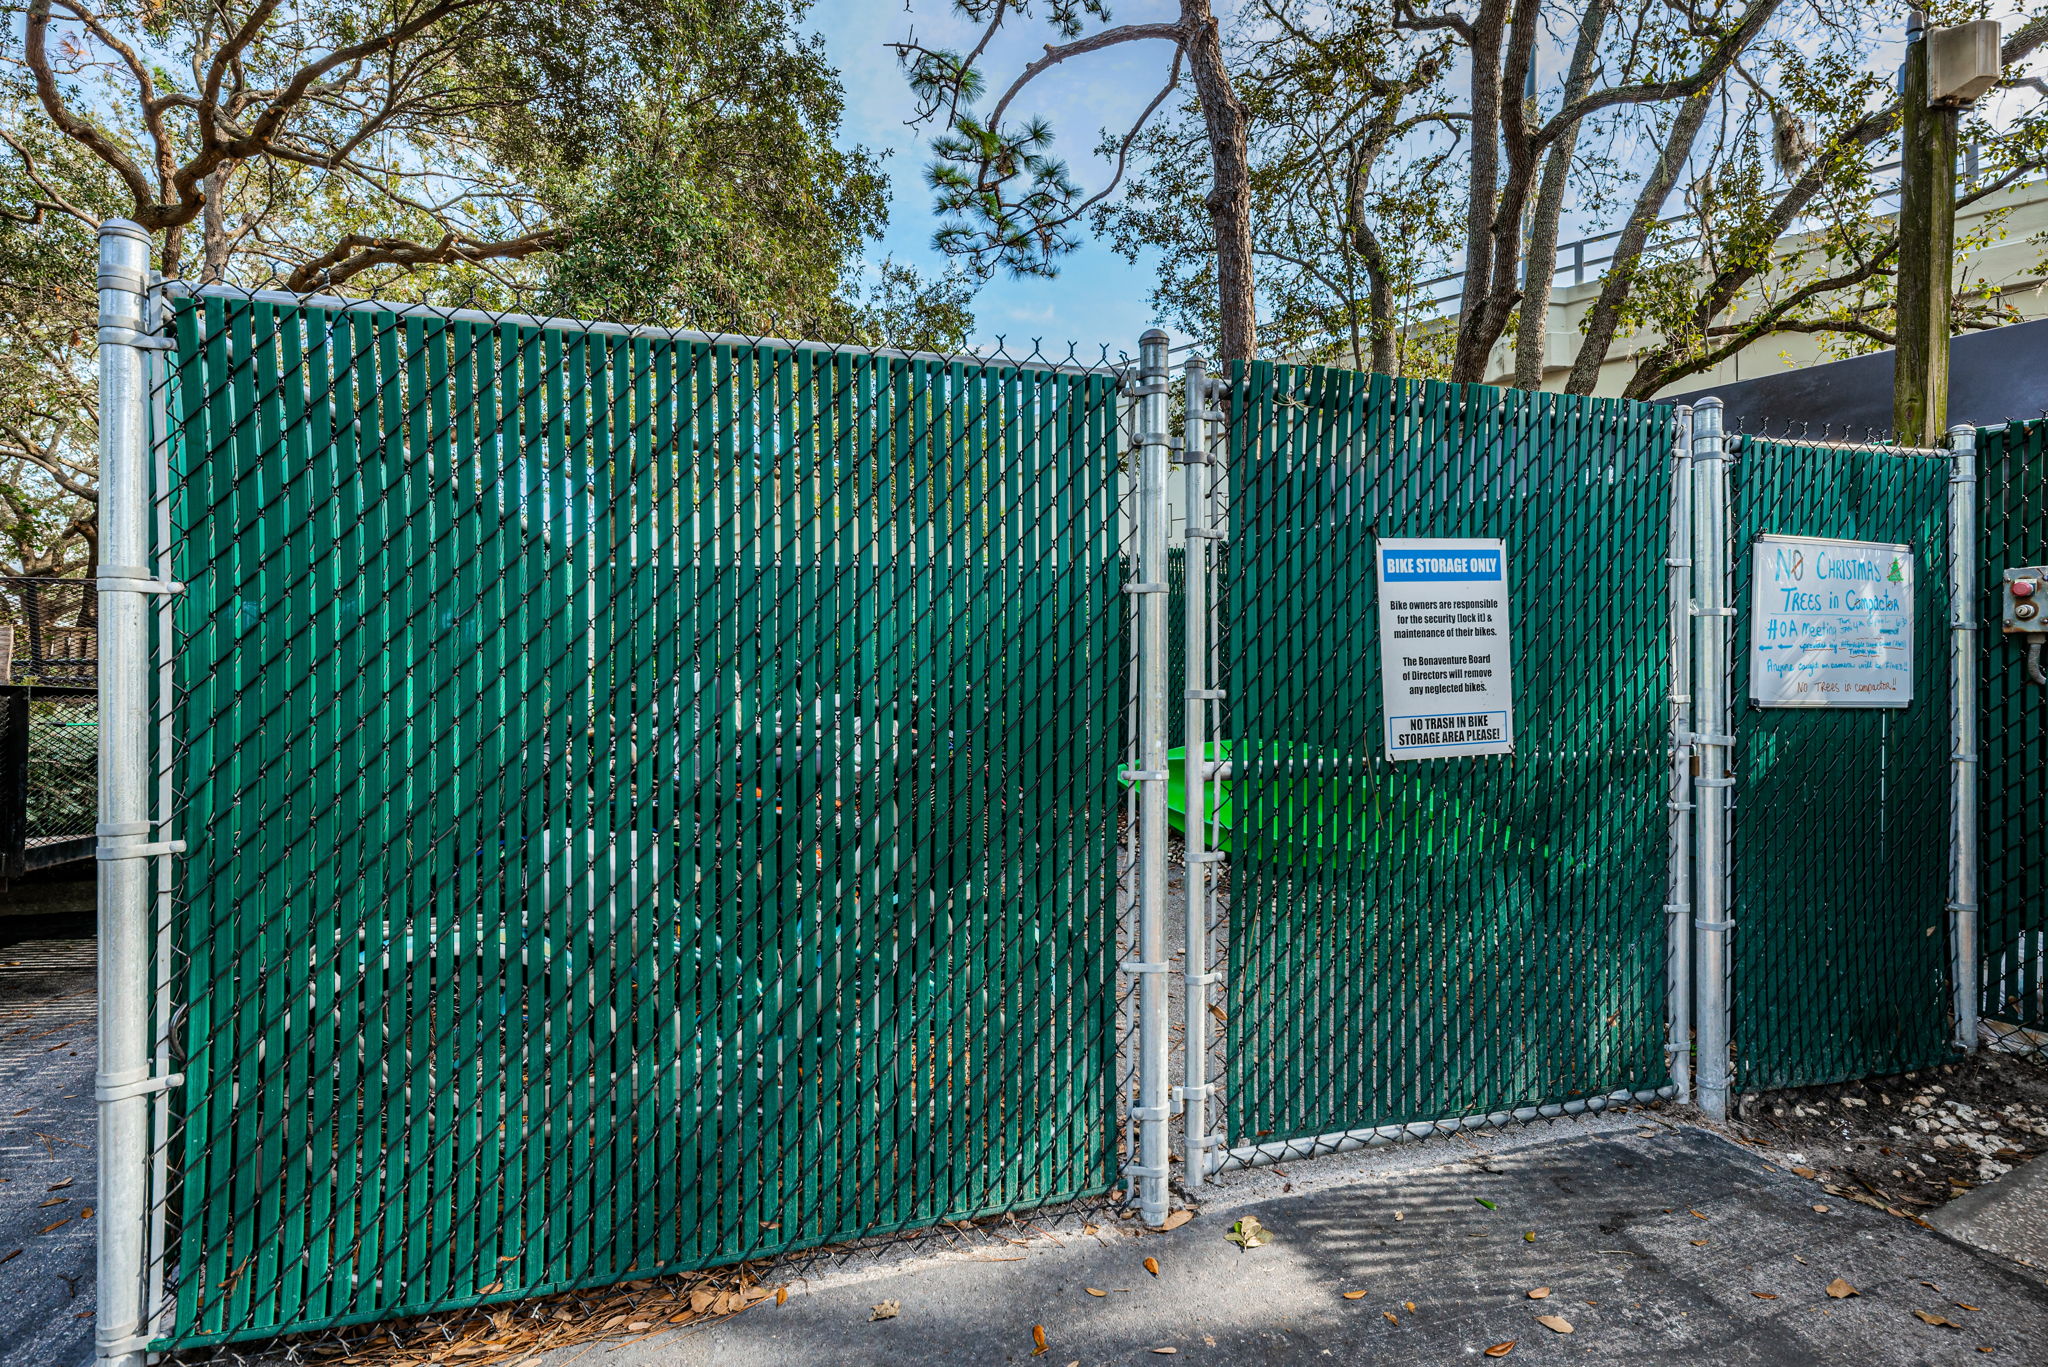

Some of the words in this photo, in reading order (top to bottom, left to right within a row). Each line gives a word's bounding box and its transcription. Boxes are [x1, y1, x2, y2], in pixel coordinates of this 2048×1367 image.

[1387, 559, 1414, 573] BIKE
[1416, 558, 1468, 573] STORAGE
[1471, 558, 1497, 573] ONLY
[1775, 549, 1804, 581] NO
[1390, 601, 1407, 610] Bike
[1409, 600, 1438, 610] owners
[1439, 601, 1452, 609] are
[1453, 599, 1498, 609] responsible
[1780, 586, 1822, 612] TREES
[1829, 591, 1839, 609] in
[1397, 615, 1408, 624] for
[1410, 615, 1422, 624] the
[1424, 614, 1455, 624] security
[1487, 614, 1492, 622] &
[1394, 629, 1445, 638] maintenance
[1446, 628, 1454, 637] of
[1456, 628, 1473, 636] their
[1475, 627, 1497, 636] bikes.
[1767, 618, 1798, 640] HOA
[1403, 657, 1417, 666] The
[1419, 655, 1467, 666] Bonaventure
[1469, 654, 1490, 664] Board
[1403, 672, 1410, 680] of
[1412, 670, 1447, 680] Directors
[1449, 669, 1462, 678] will
[1464, 669, 1492, 678] remove
[1410, 687, 1423, 695] any
[1425, 684, 1463, 694] neglected
[1465, 683, 1487, 692] bikes.
[1410, 718, 1422, 731] NO
[1425, 717, 1454, 730] TRASH
[1457, 716, 1466, 728] IN
[1468, 715, 1488, 727] BIKE
[1399, 732, 1440, 746] STORAGE
[1442, 731, 1464, 743] AREA
[1467, 728, 1500, 741] PLEASE!
